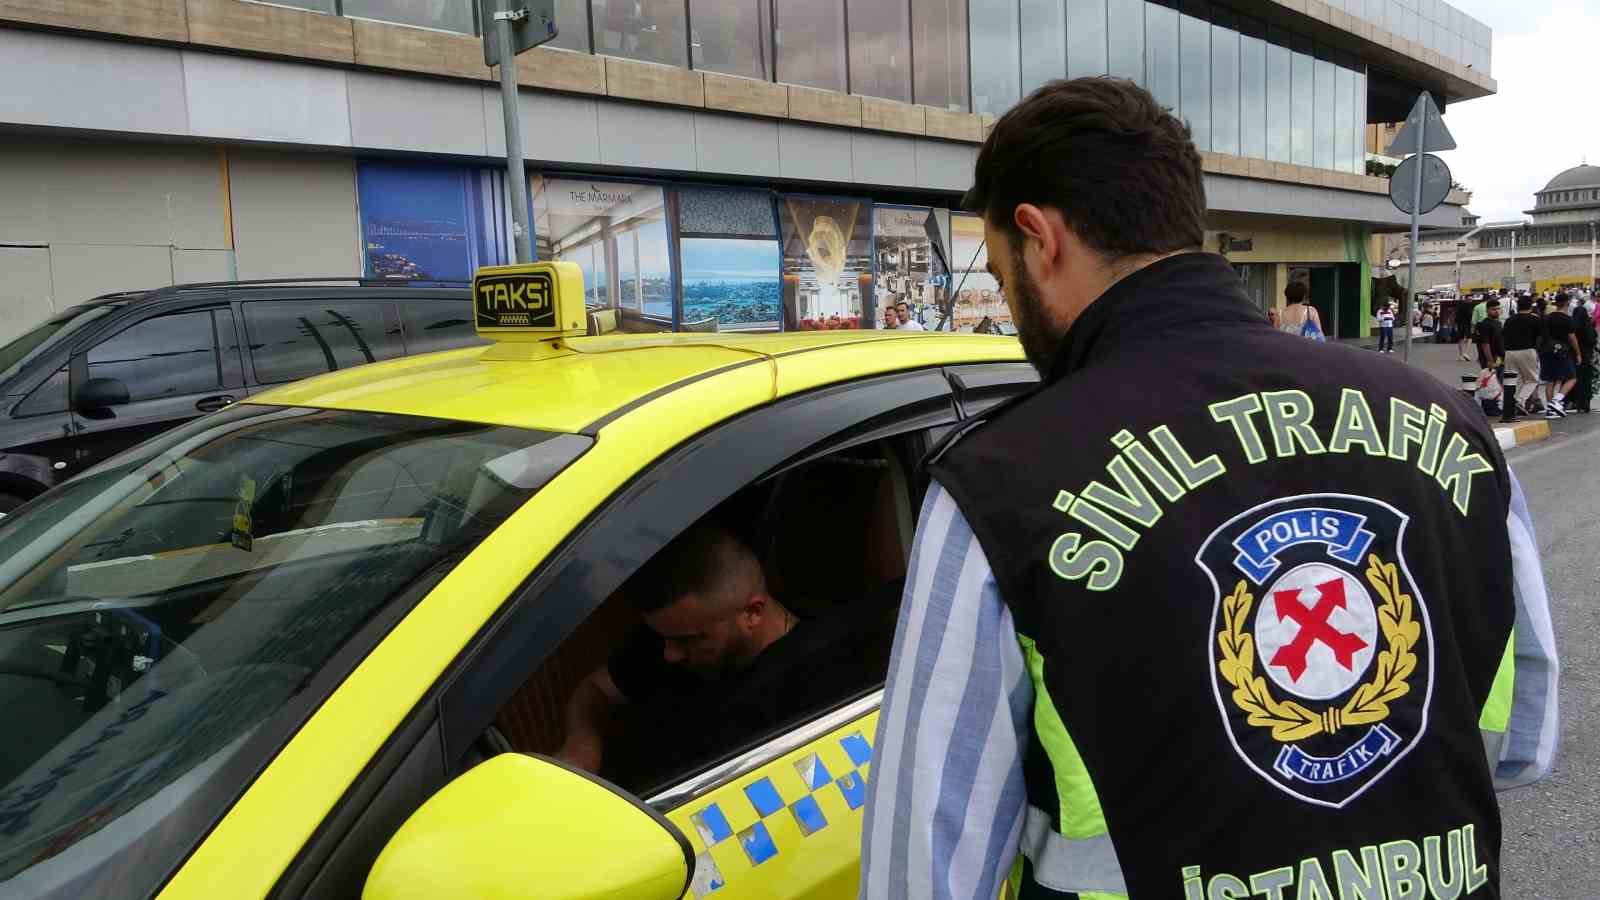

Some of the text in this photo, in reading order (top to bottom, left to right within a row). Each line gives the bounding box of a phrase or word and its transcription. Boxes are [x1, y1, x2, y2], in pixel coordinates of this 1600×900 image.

[569, 191, 586, 202] THE
[1048, 387, 1495, 592] SİVİL TRAFİK
[1254, 511, 1341, 554] POLİS
[1299, 743, 1374, 780] TRAFİK
